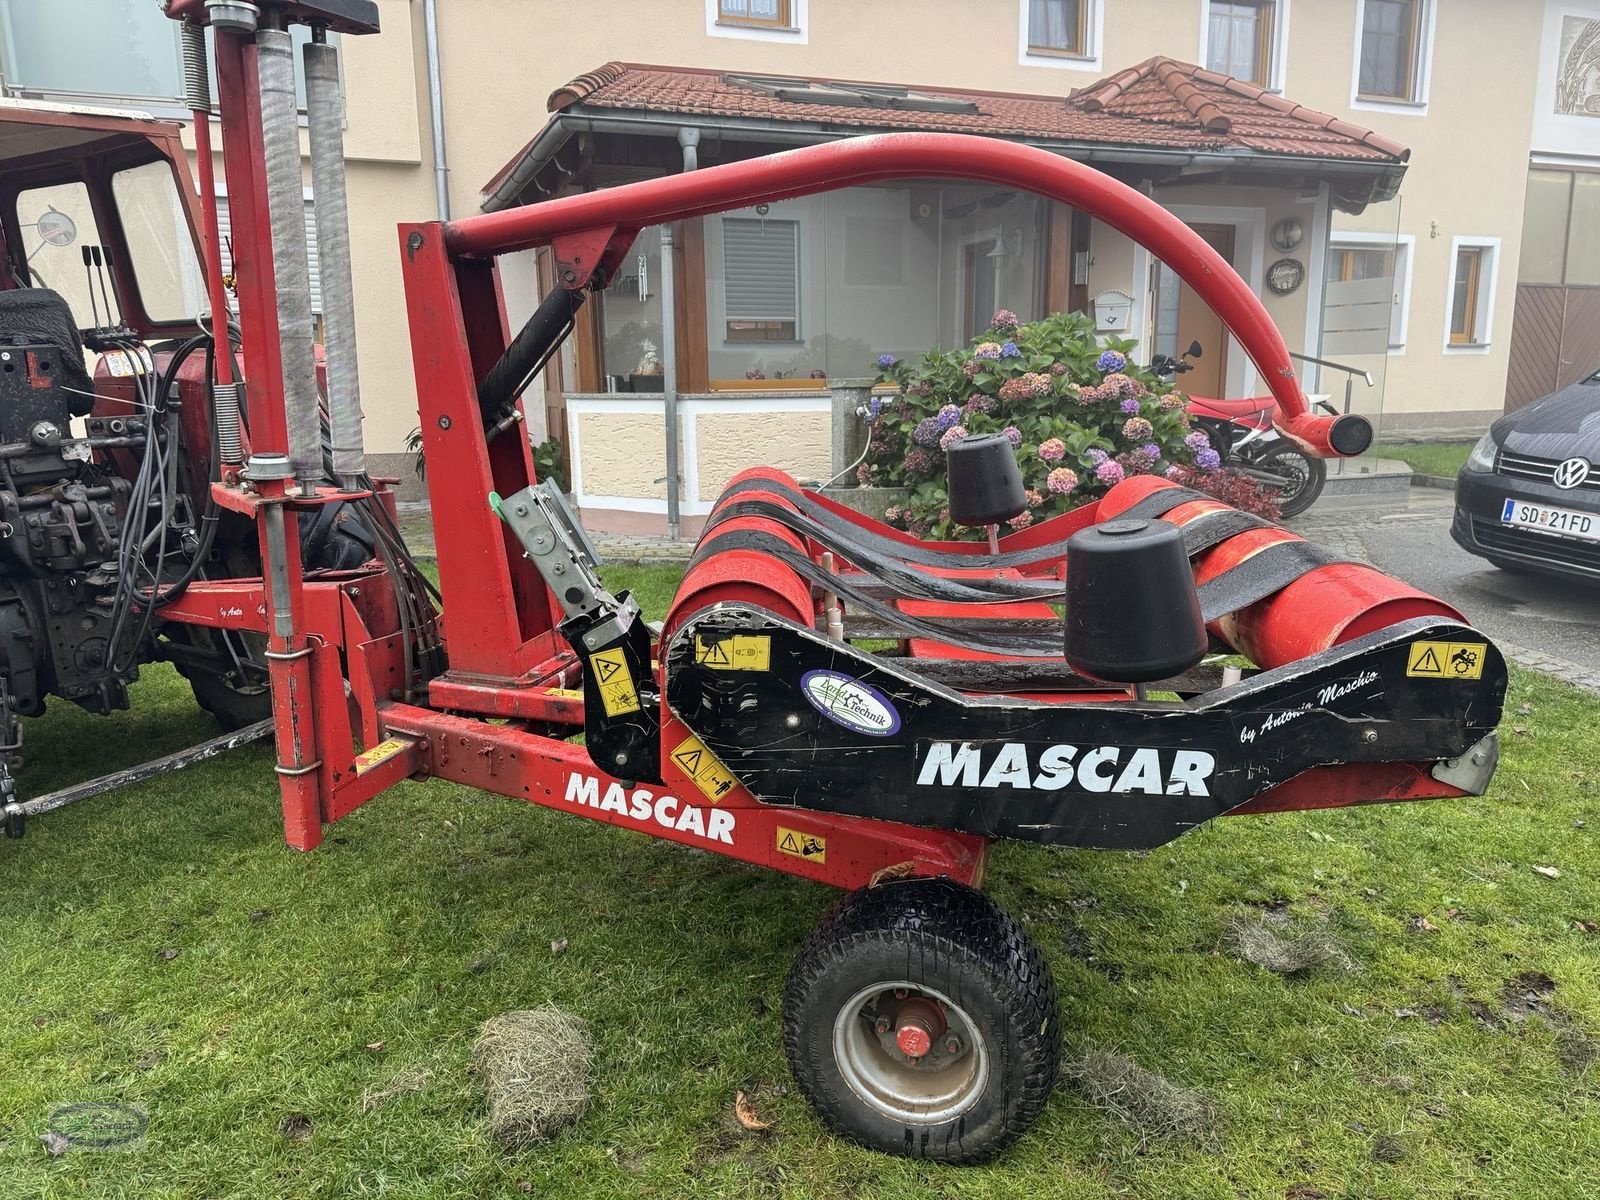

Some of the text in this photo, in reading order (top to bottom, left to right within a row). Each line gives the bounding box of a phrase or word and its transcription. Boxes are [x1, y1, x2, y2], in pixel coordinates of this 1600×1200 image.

[1272, 267, 1298, 278] Home
[1520, 506, 1539, 523] SD
[821, 679, 847, 698] Land
[849, 701, 886, 726] Technik
[1240, 671, 1379, 743] by Antonio Maschio
[916, 742, 1216, 797] MASCAR
[564, 771, 736, 846] MASCAR
